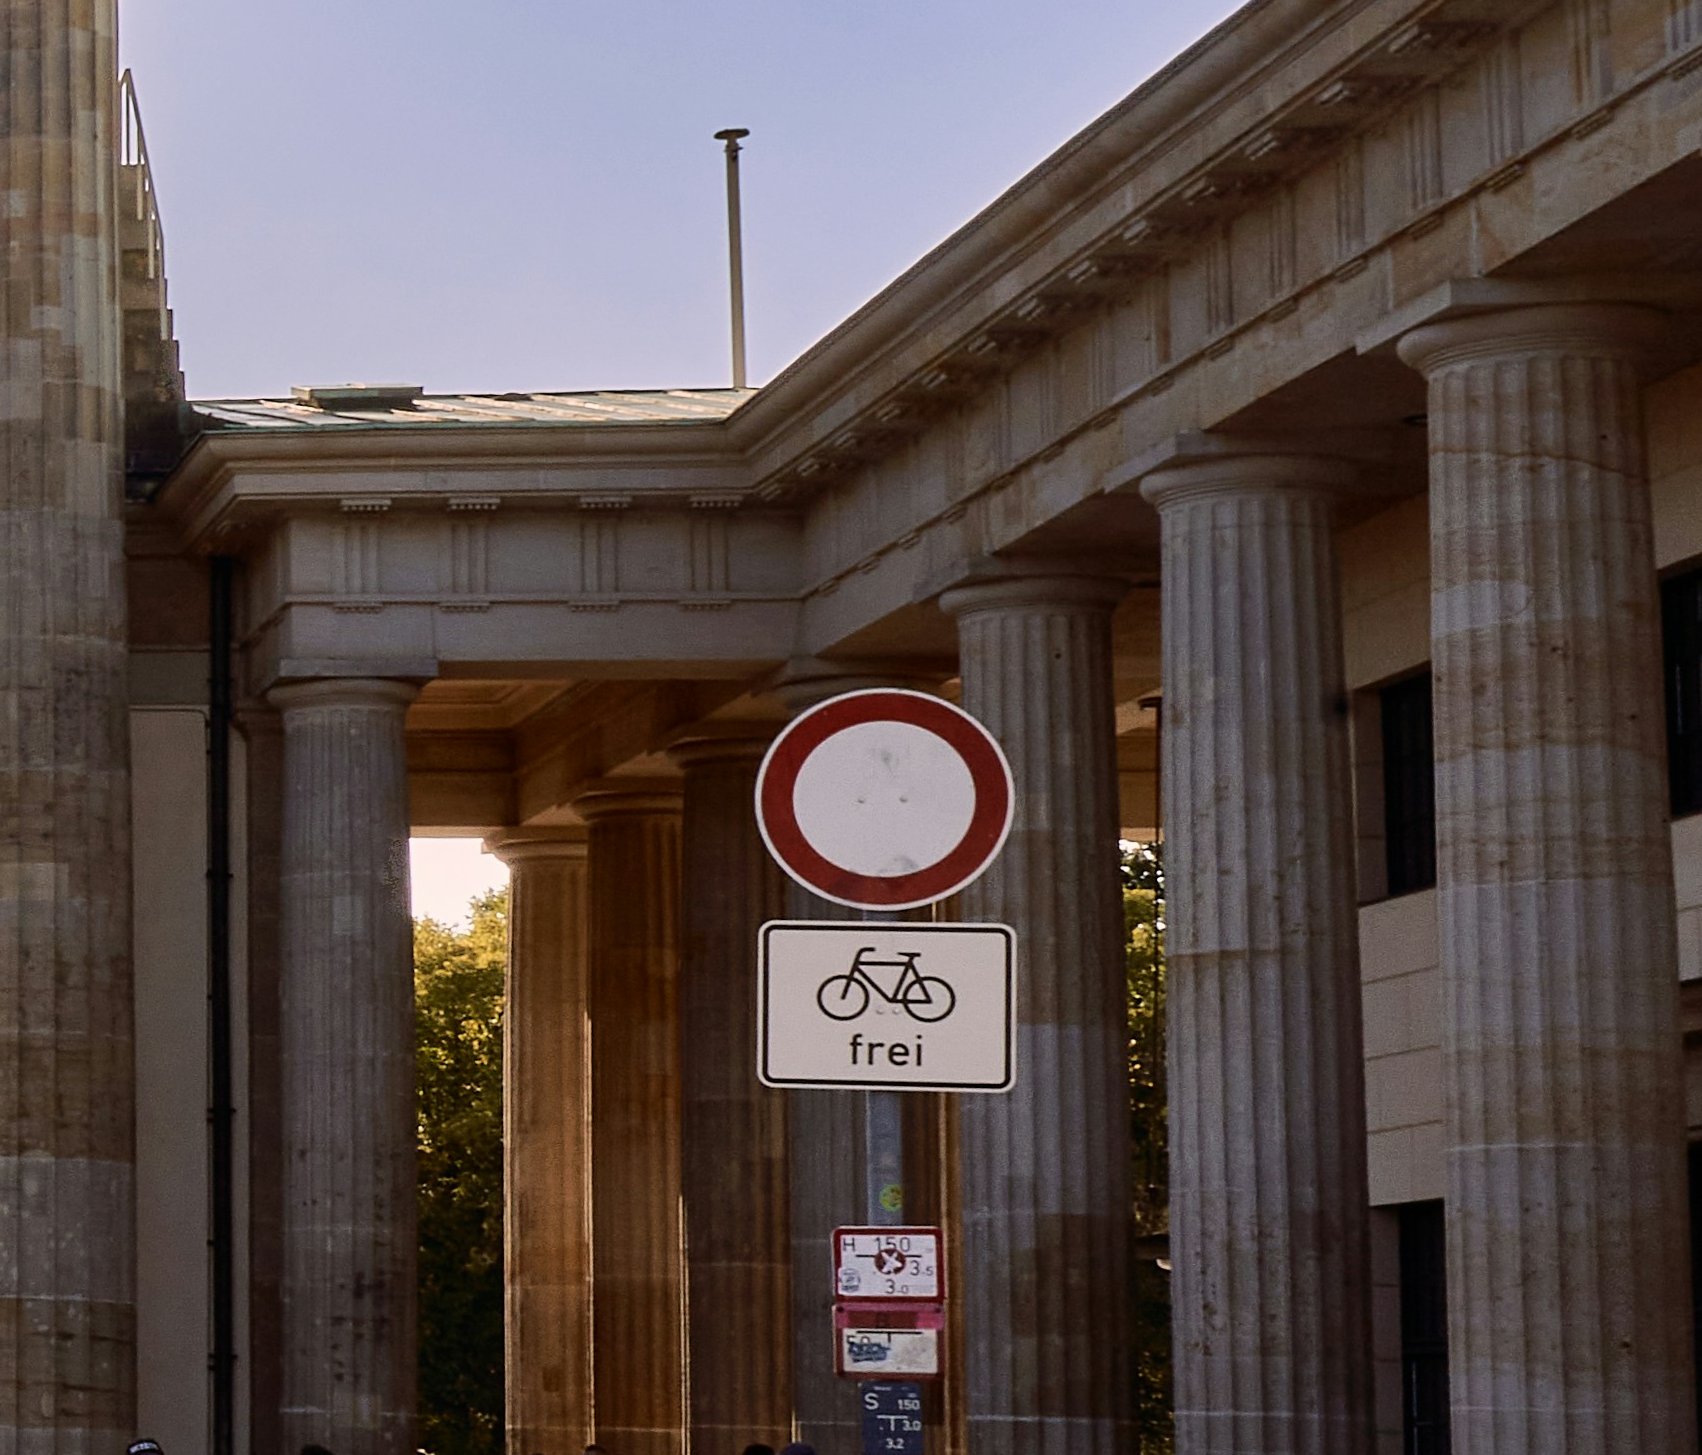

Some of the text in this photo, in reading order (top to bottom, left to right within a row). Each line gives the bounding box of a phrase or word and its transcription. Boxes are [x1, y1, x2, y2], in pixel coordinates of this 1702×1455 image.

[849, 1033, 922, 1066] frei
[842, 1237, 911, 1253] H 150
[864, 1393, 921, 1411] S 150
